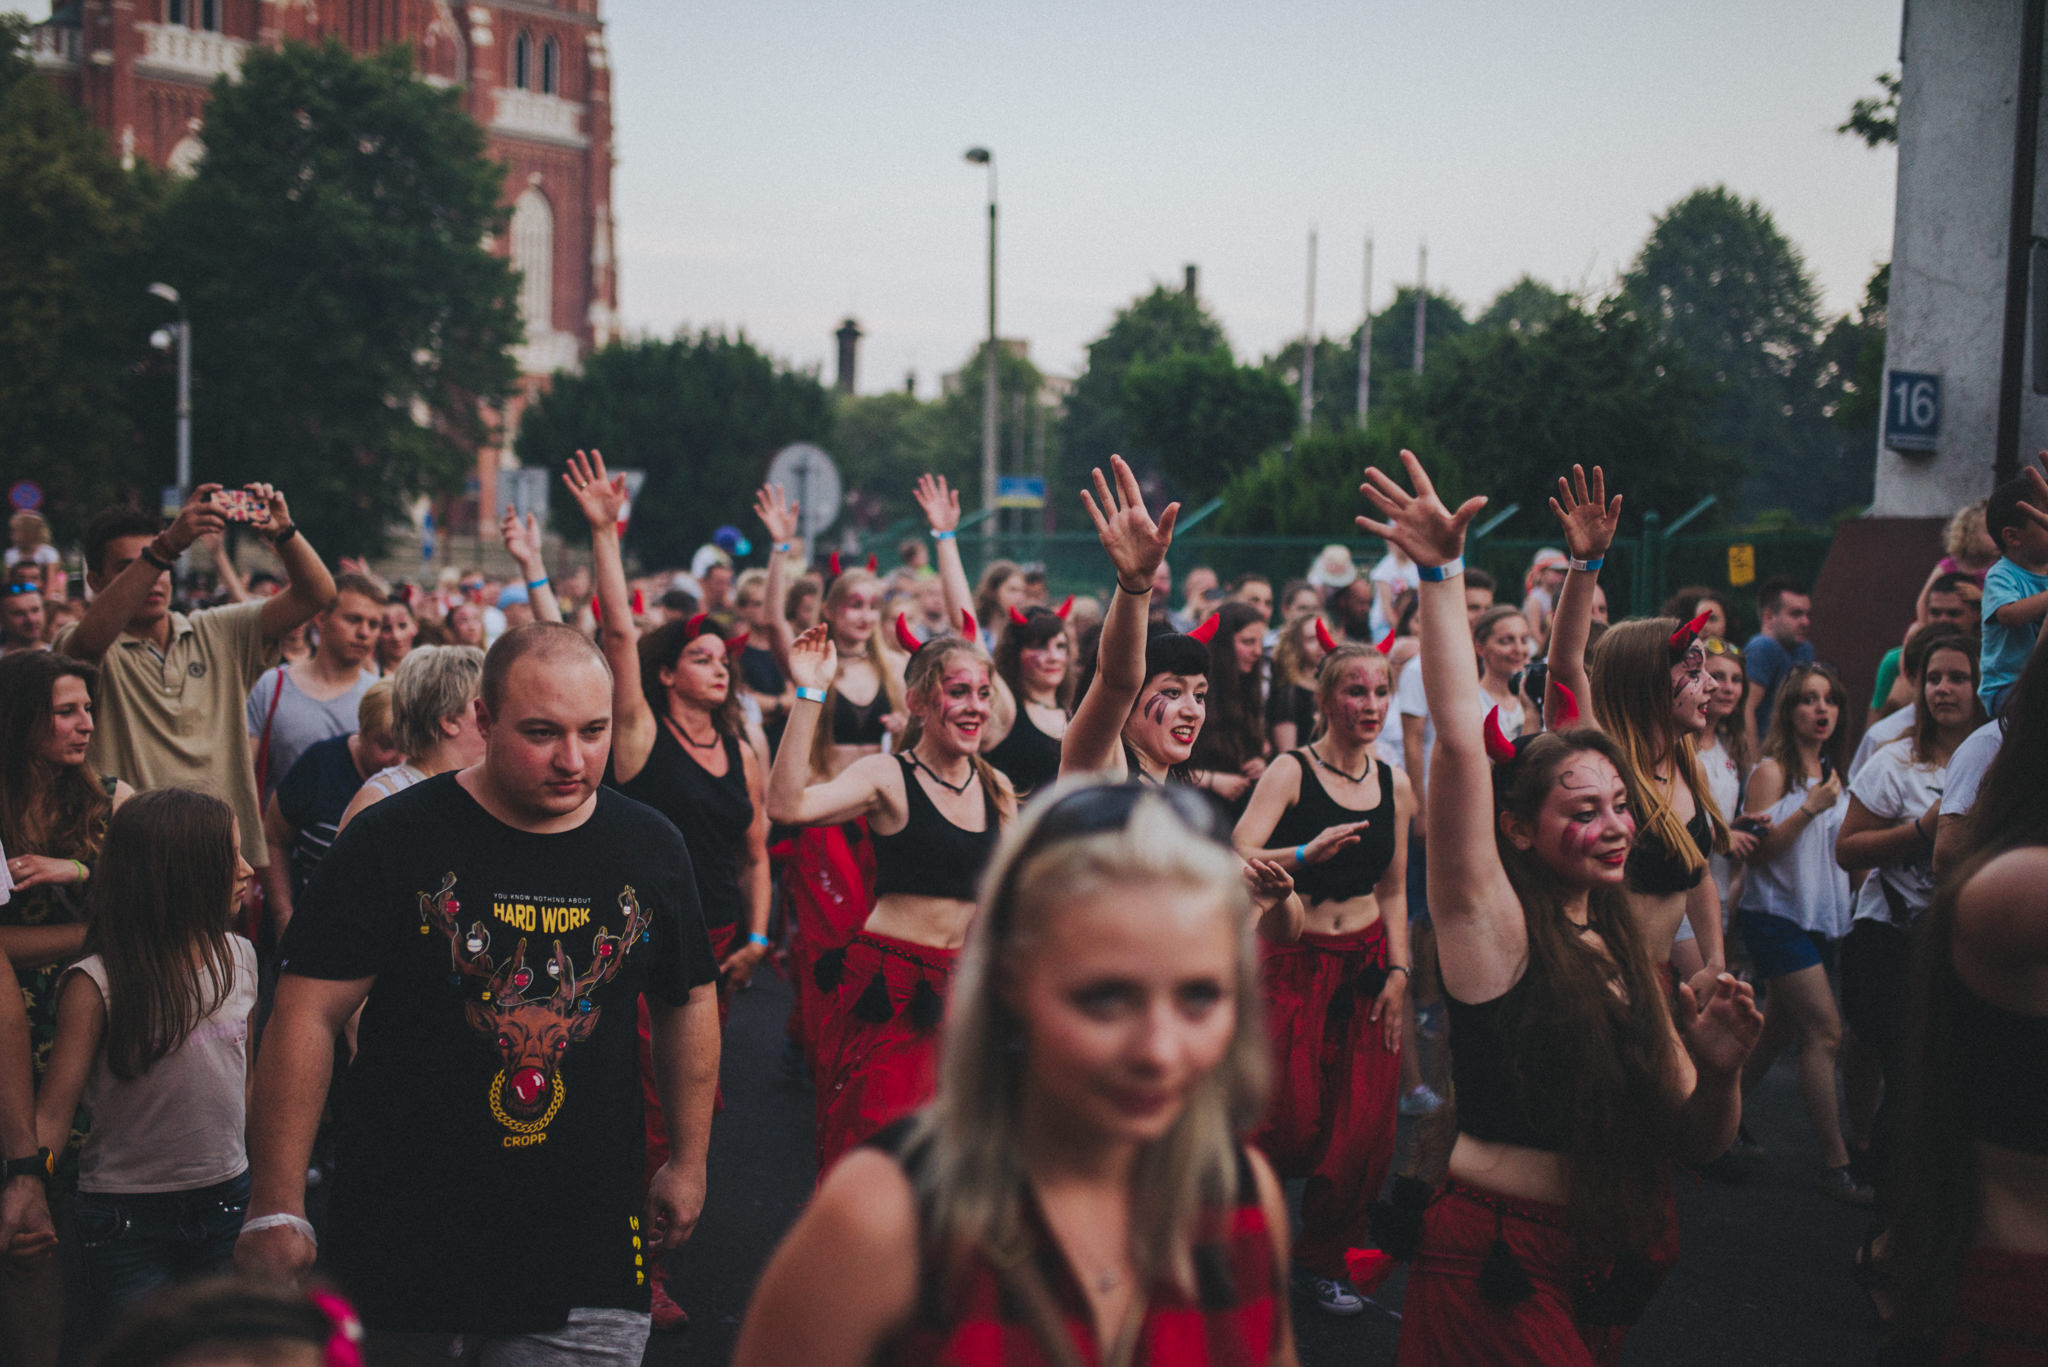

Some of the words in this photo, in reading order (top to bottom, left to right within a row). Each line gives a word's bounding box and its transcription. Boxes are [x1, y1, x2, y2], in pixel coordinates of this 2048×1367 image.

[1893, 381, 1935, 428] 16
[493, 903, 536, 932] HARD
[541, 906, 590, 933] WORK
[503, 1133, 547, 1148] CROPP
